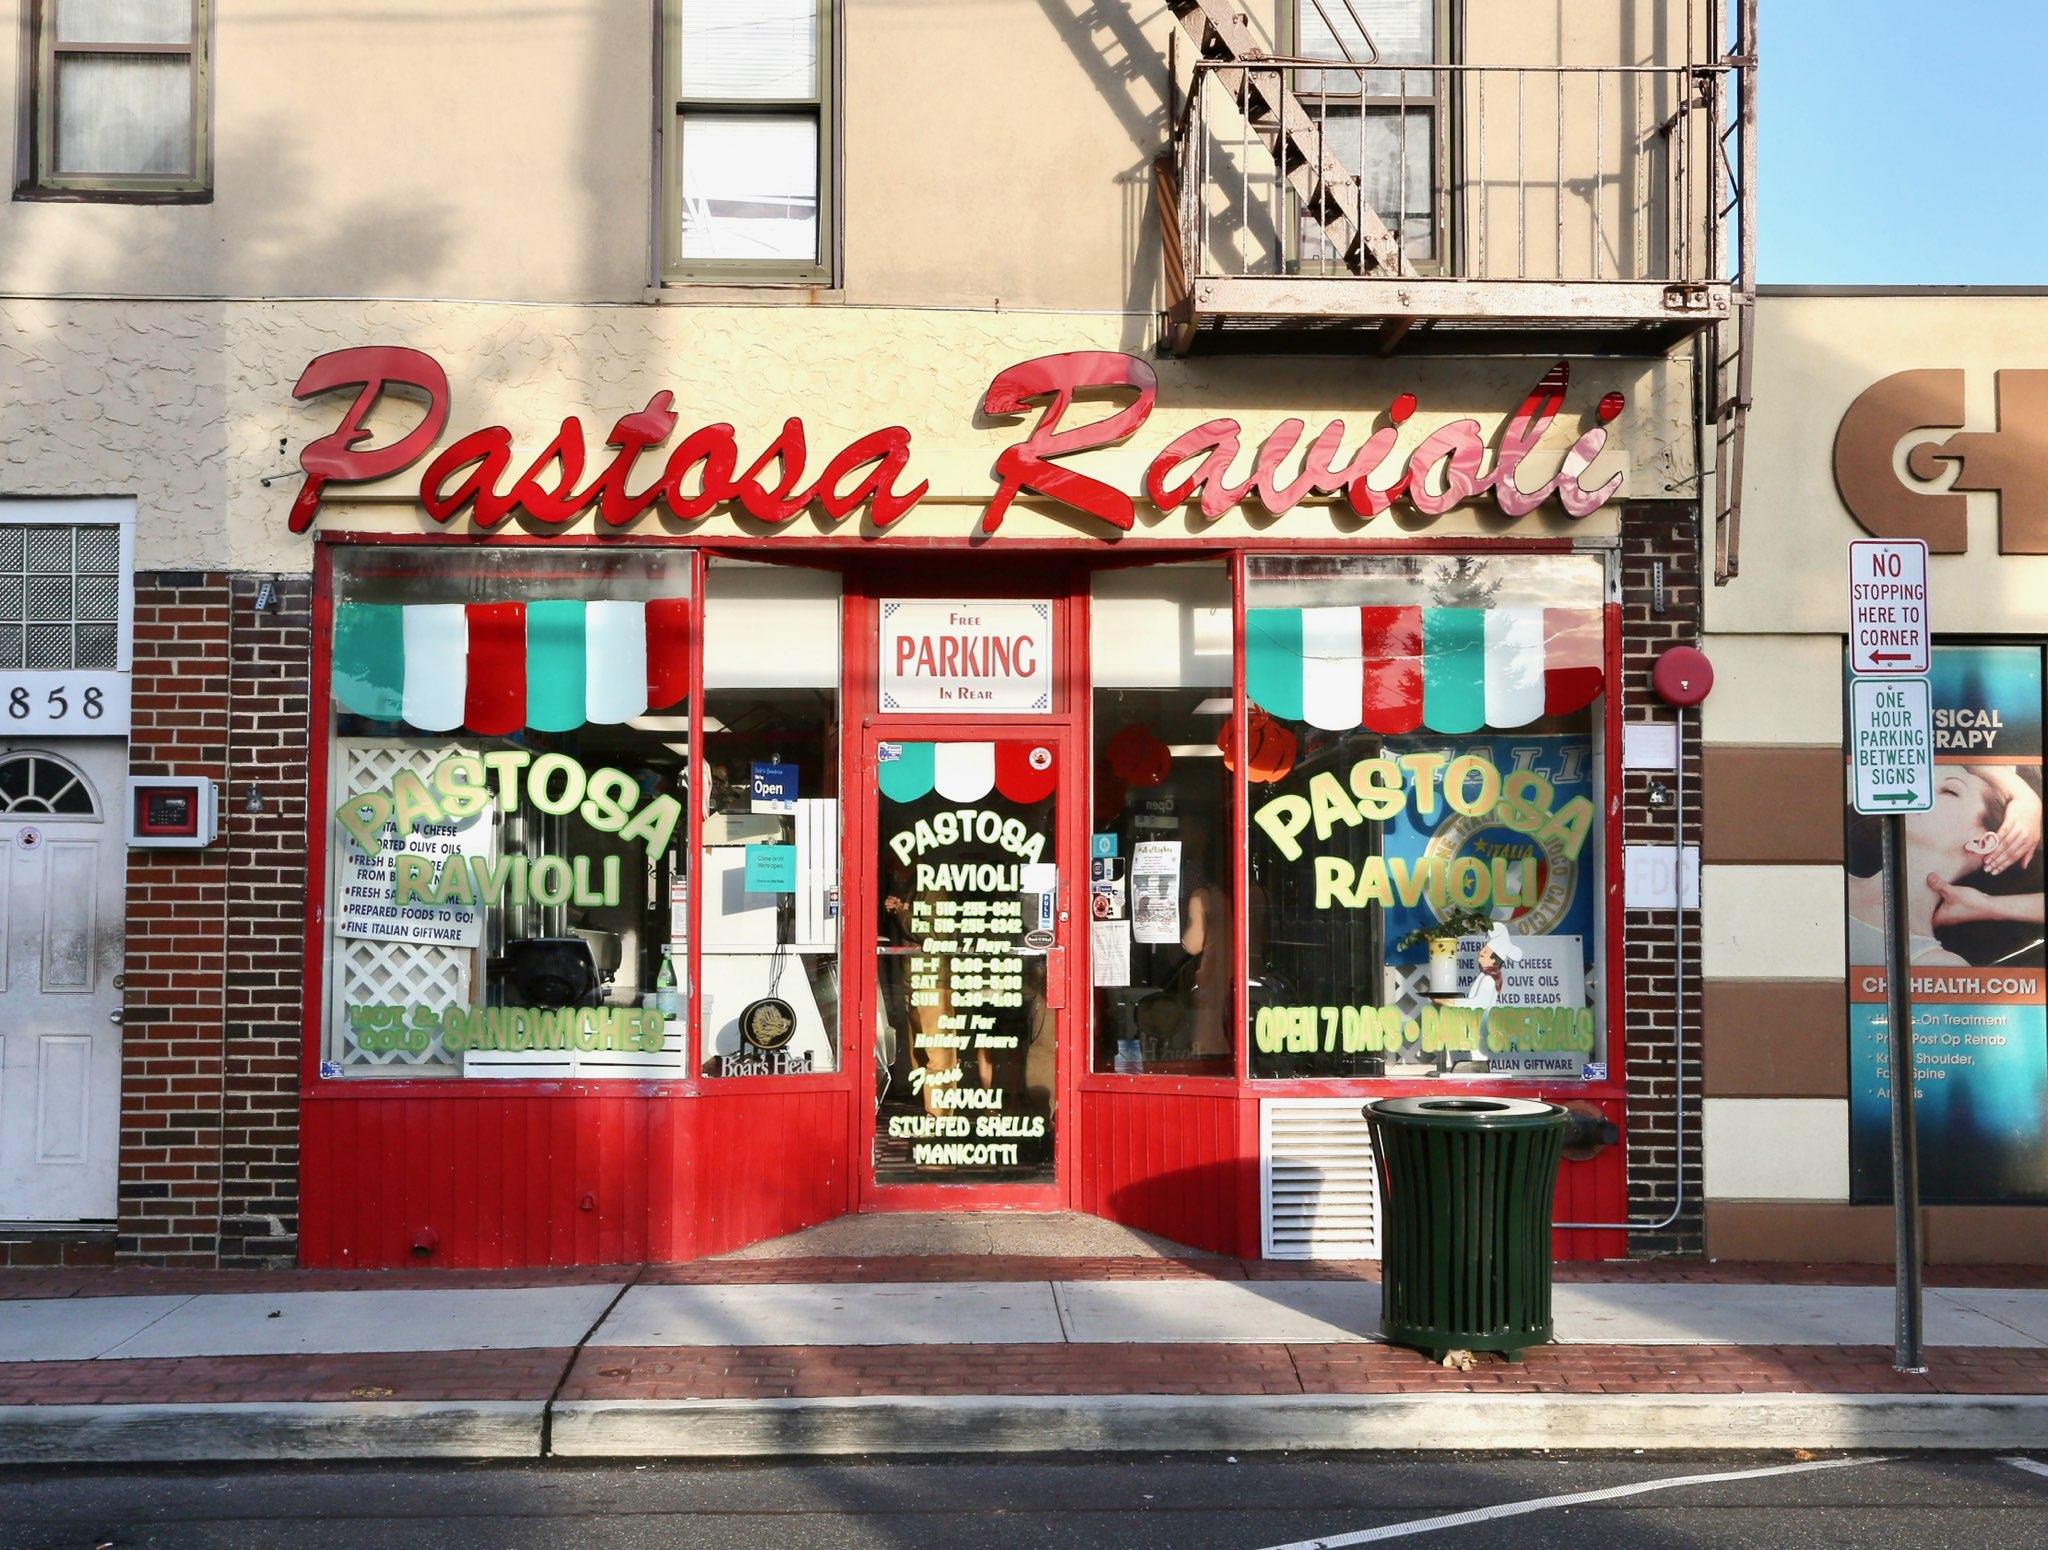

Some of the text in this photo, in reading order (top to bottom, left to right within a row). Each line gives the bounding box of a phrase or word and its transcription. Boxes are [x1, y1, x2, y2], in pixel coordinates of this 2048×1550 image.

[288, 345, 1624, 534] Pastosa Ravioli
[1872, 553, 1902, 578] NO
[1854, 584, 1923, 600] STOPPING
[1858, 607, 1919, 623] HERE TO
[1860, 630, 1919, 646] CORNER
[896, 635, 1036, 678] PARKING
[8, 685, 104, 720] 858
[1876, 692, 1905, 708] ONE
[1871, 711, 1911, 728] HOUR
[1932, 709, 2003, 728] SICAL
[1861, 730, 1924, 746] PARKING
[1933, 730, 1997, 749] RAPY
[1860, 749, 1925, 766] BETWEEN
[1872, 768, 1915, 785] SIGNS
[754, 780, 783, 797] Open
[335, 750, 682, 861] PASTOSA
[1254, 753, 1595, 862] PASTOSA
[423, 826, 458, 837] CHEESE
[889, 809, 1046, 867] PASTOSA
[409, 841, 436, 853] OLIVE
[441, 844, 461, 855] OILS
[354, 854, 384, 867] FRESH
[357, 869, 385, 881] FROM
[394, 854, 620, 907] RAVIOLI
[916, 863, 1019, 892] RAVIOLI
[1314, 855, 1538, 909] RAVIOLI
[351, 886, 380, 898] FRESH
[349, 904, 474, 924] PREPARED FOODS TO GO!
[346, 922, 462, 941] FINE ITALIAN GIFTWARE
[923, 938, 958, 954] Open
[962, 938, 973, 952] 7
[975, 938, 1011, 954] Days
[911, 958, 940, 972] M-F
[1518, 958, 1552, 969] CHEESE
[911, 975, 938, 989] SAT
[1507, 976, 1559, 987] OLIVE OILS
[911, 992, 940, 1006] SUN
[1496, 994, 1561, 1004] AKED BREADS
[350, 1005, 406, 1028] HOT
[937, 1014, 967, 1029] Call
[1943, 1014, 2007, 1025] Treatment
[441, 1006, 665, 1053] SANDWICHES
[1255, 1005, 1594, 1053] OPEN 7 DAYS DAILY SPECIALS
[357, 1029, 430, 1051] COLD
[914, 1033, 1018, 1049] Holiday Hours
[1912, 1033, 1937, 1045] Post
[1941, 1034, 1961, 1046] Op
[1965, 1033, 2006, 1045] Rehab
[721, 1050, 814, 1077] Boar's Head
[1489, 1059, 1573, 1070] TALIAN GIFTWARE
[1916, 1053, 1976, 1066] Shoulder,
[908, 1062, 963, 1096] Fresh
[931, 1088, 1002, 1109] RAVIOLI
[888, 1116, 1045, 1138] STUFFED SHELLS
[914, 1143, 1018, 1165] MANICOTTI
